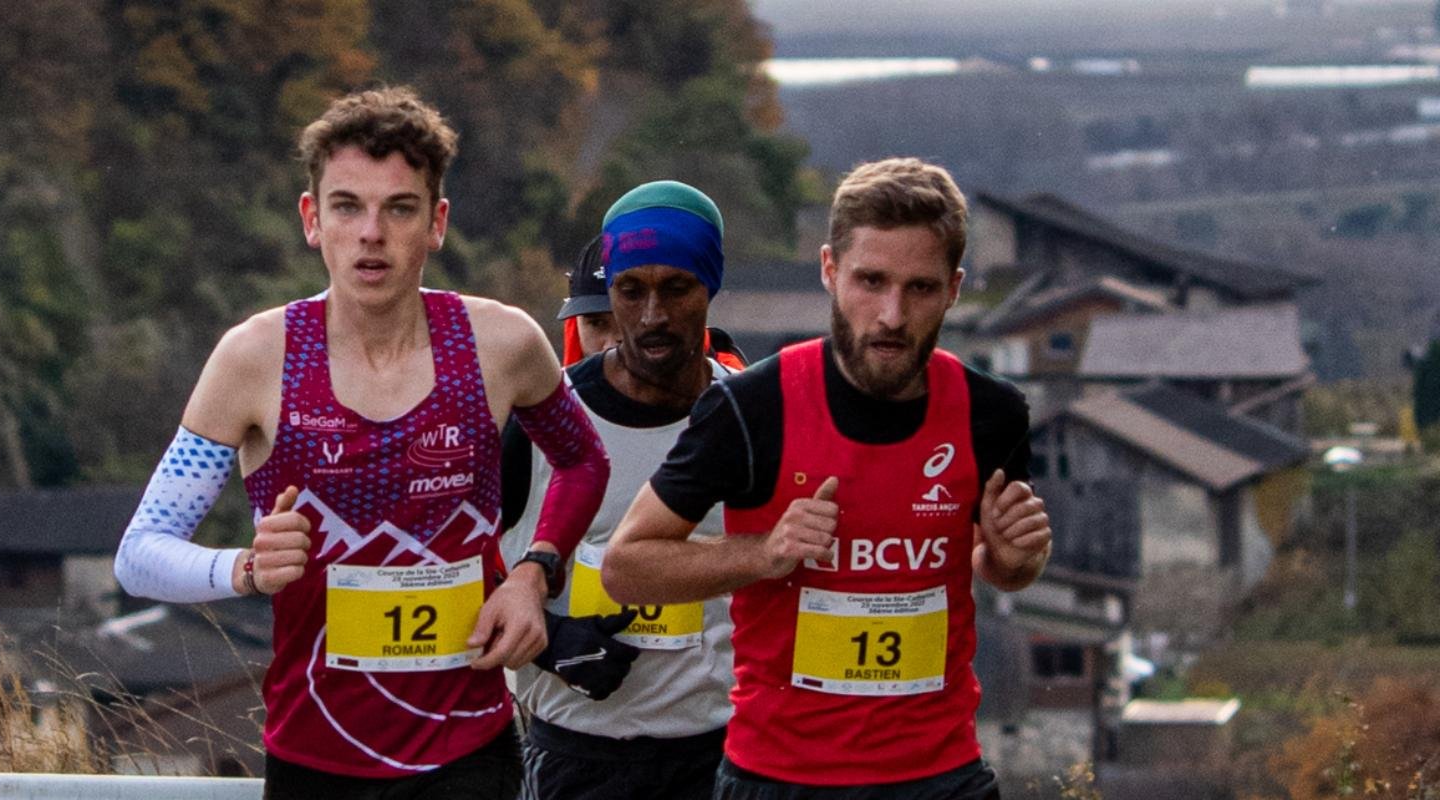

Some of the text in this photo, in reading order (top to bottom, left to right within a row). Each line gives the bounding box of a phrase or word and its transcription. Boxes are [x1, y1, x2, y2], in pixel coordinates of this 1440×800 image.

[301, 414, 346, 428] SeGaM
[422, 423, 460, 448] WTR
[850, 537, 949, 571] BCVS
[384, 604, 437, 642] 12
[626, 622, 668, 634] ONEN
[382, 643, 437, 656] ROMAIN
[850, 631, 902, 667] 13
[844, 668, 901, 680] BASTIEN
